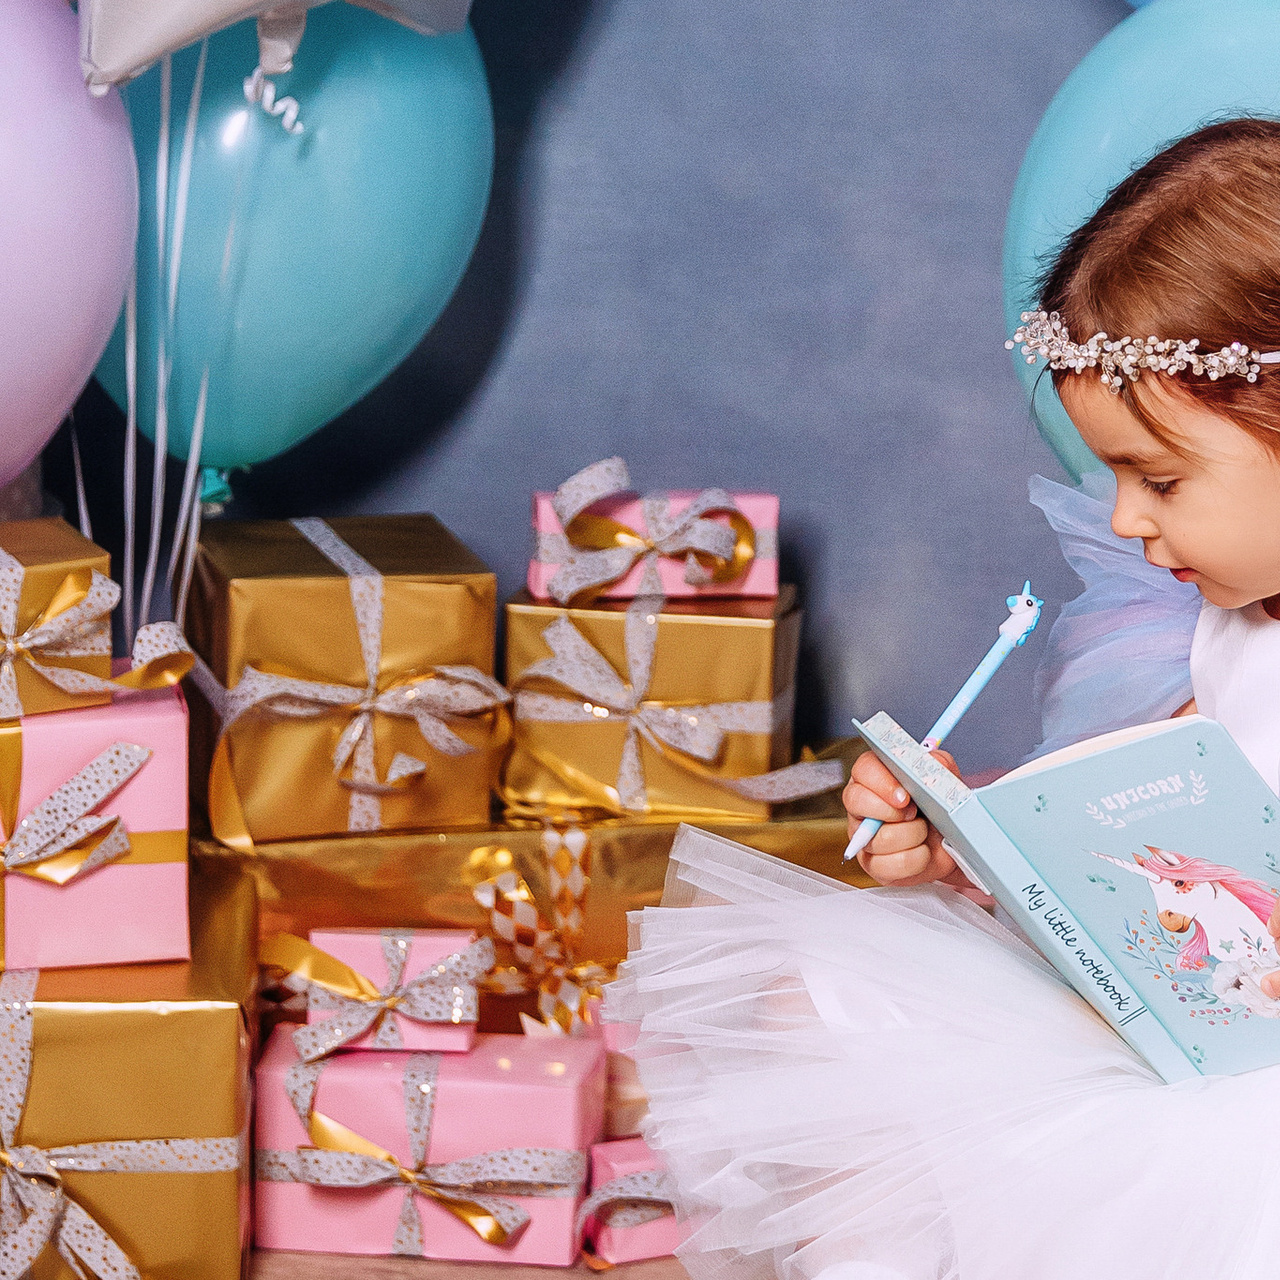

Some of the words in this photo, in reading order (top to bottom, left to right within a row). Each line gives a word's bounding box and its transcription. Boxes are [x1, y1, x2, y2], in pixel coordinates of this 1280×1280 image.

[1100, 774, 1185, 811] UNICORN
[1022, 883, 1046, 911] My
[1044, 907, 1077, 948] little
[1075, 948, 1131, 1012] notebook
